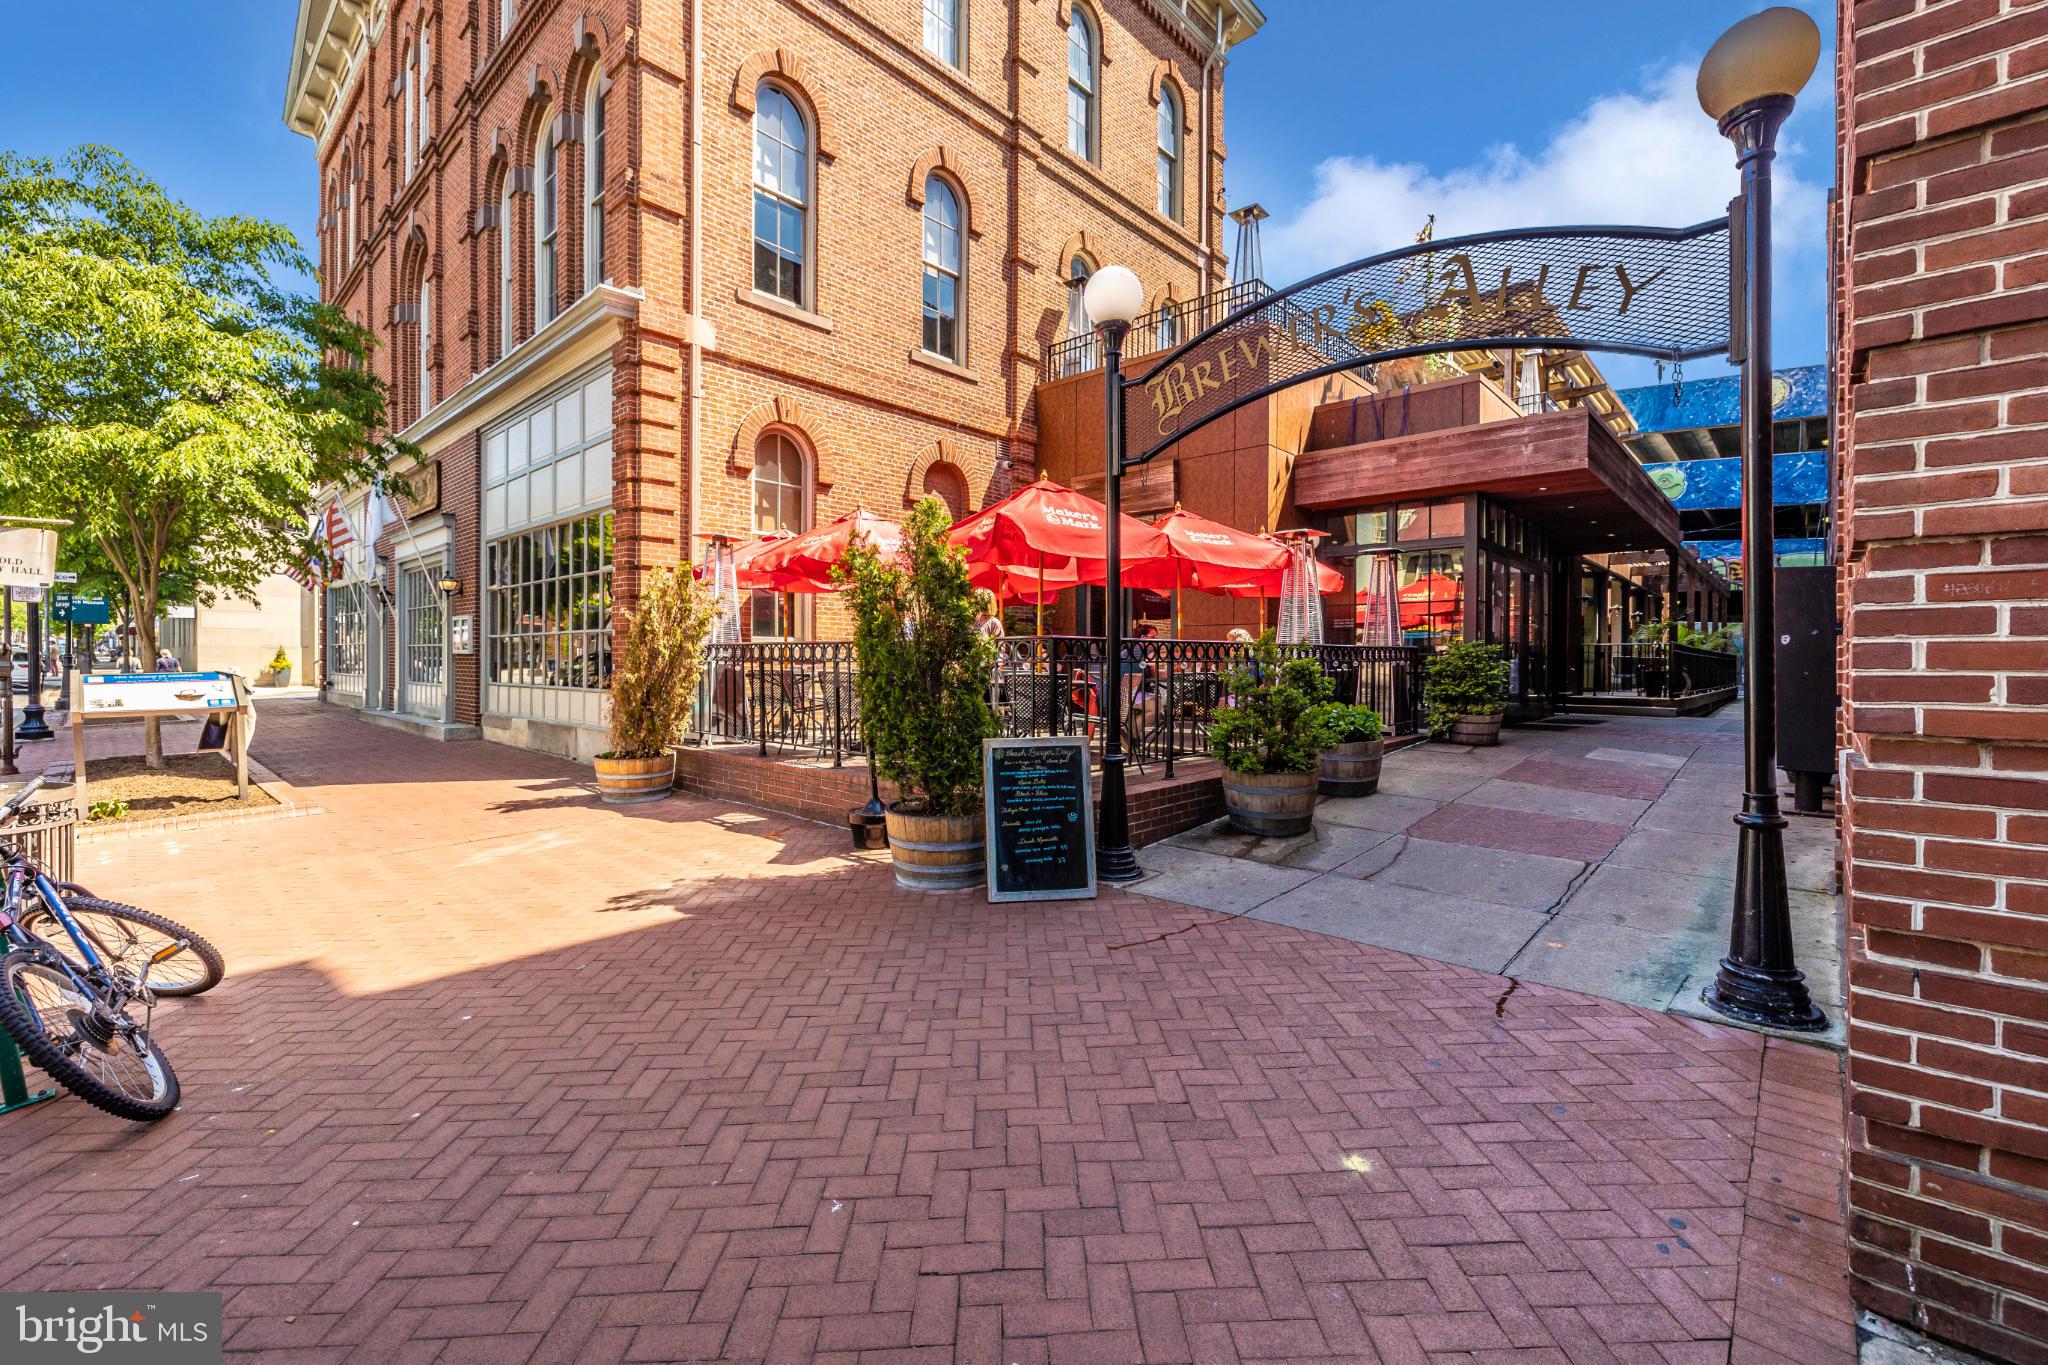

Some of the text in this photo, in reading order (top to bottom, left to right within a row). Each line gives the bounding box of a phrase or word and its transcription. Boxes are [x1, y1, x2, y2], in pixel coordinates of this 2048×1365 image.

[1042, 504, 1098, 521] Maker's
[1060, 516, 1102, 530] Mark
[11, 566, 45, 576] HALL
